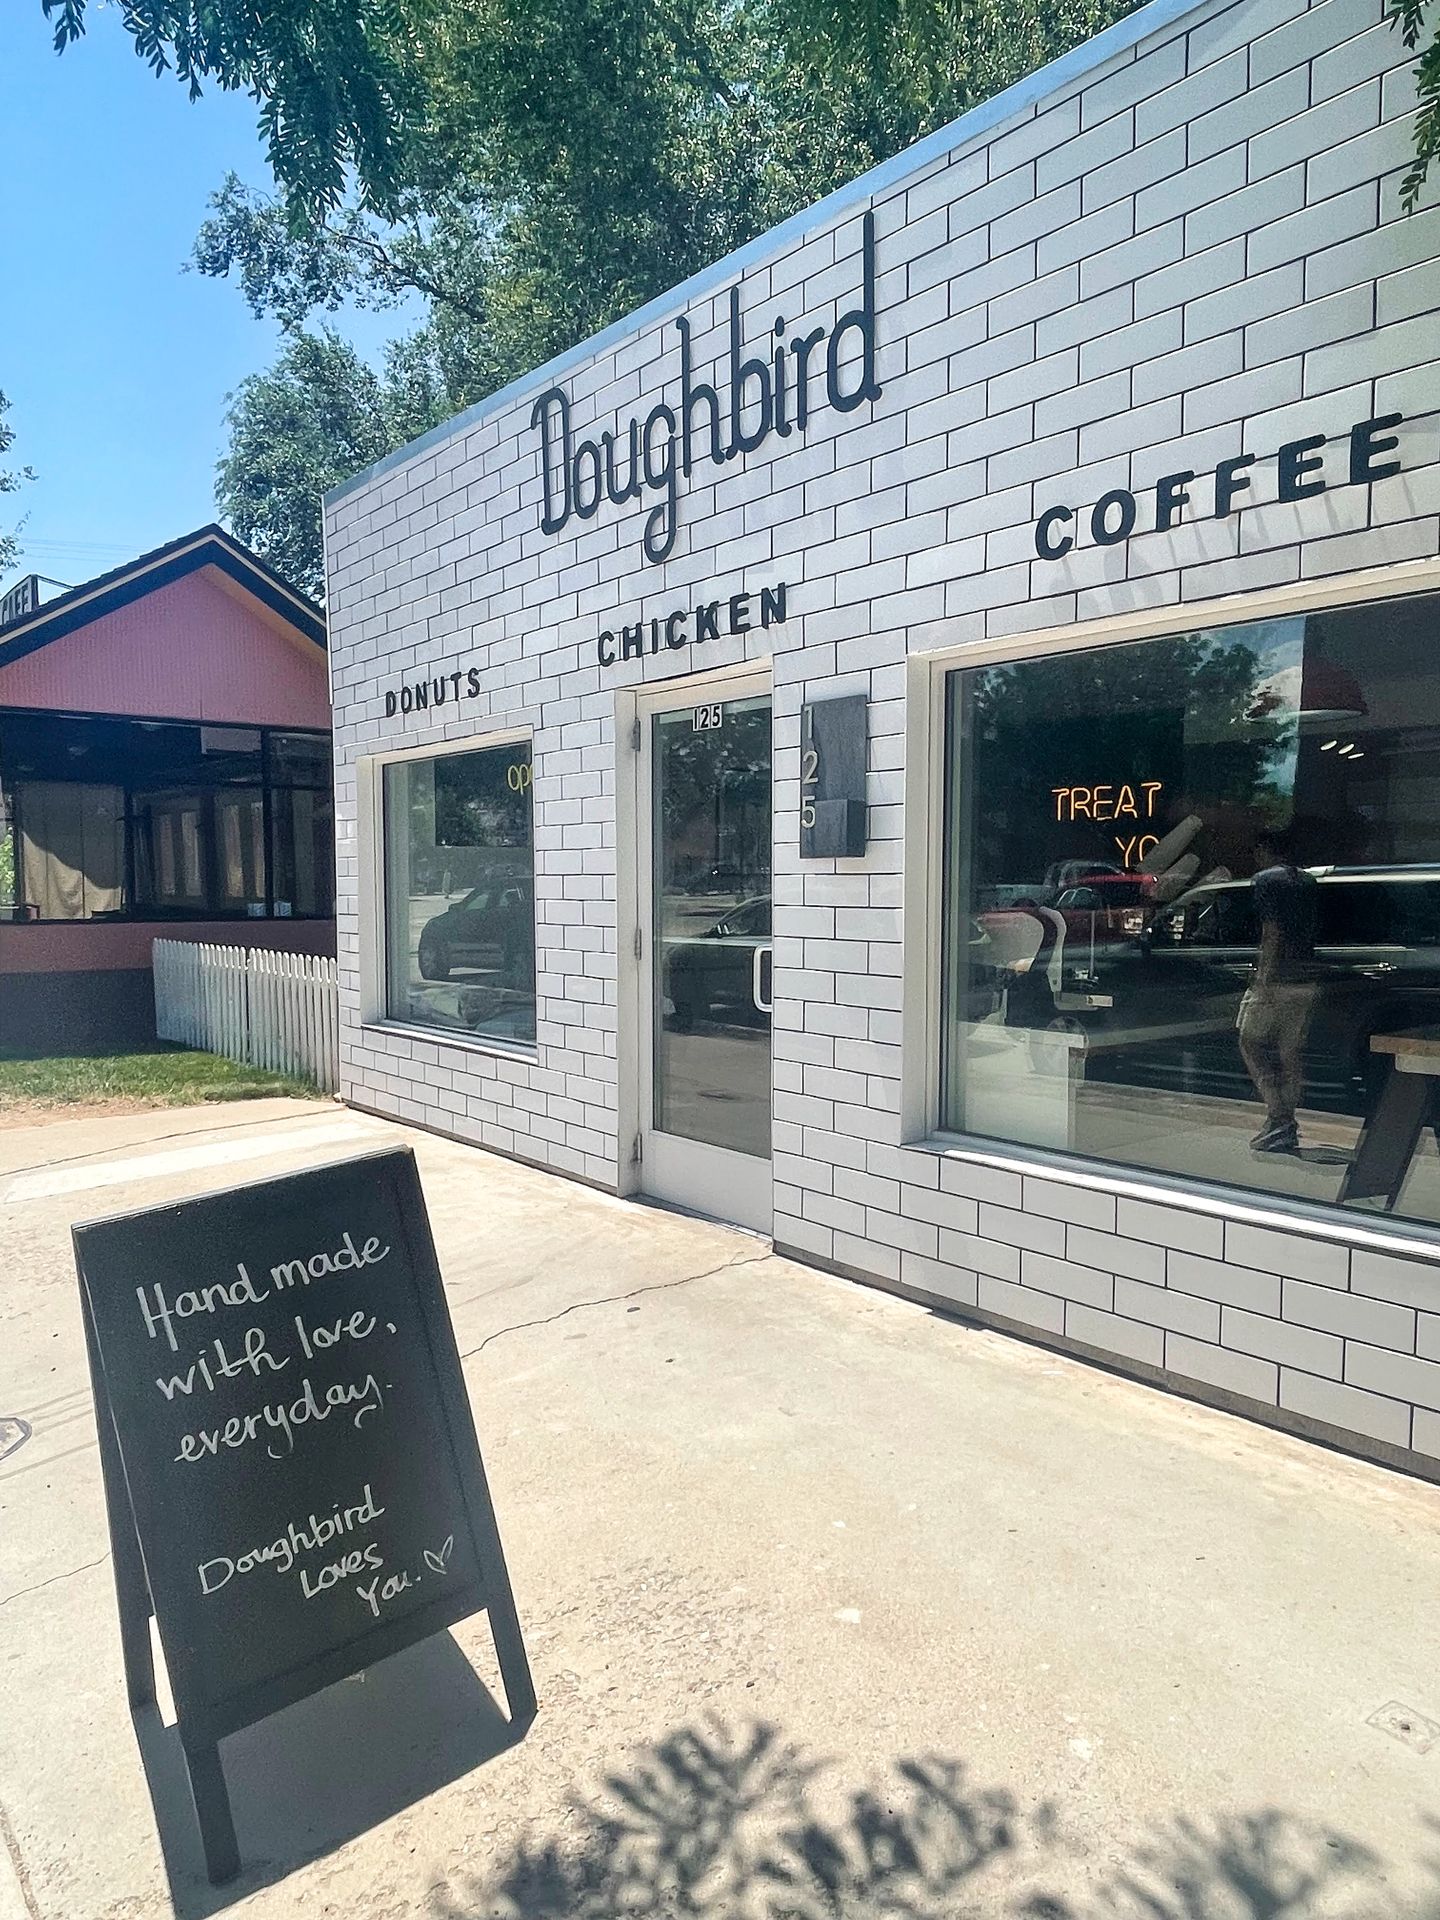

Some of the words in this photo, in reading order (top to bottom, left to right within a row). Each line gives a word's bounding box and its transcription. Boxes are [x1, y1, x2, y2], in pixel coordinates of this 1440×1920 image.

[530, 210, 883, 564] Doughbird
[1035, 412, 1403, 561] COFFEE
[598, 582, 786, 667] CHICKEN
[385, 667, 481, 718] DONUTS
[693, 704, 722, 731] 125
[1051, 781, 1162, 821] TREAT
[136, 1263, 270, 1352] Hand
[270, 1232, 391, 1290] made
[156, 1327, 291, 1401] with
[198, 1484, 386, 1595] Doughbird
[300, 1543, 384, 1599] Loves
